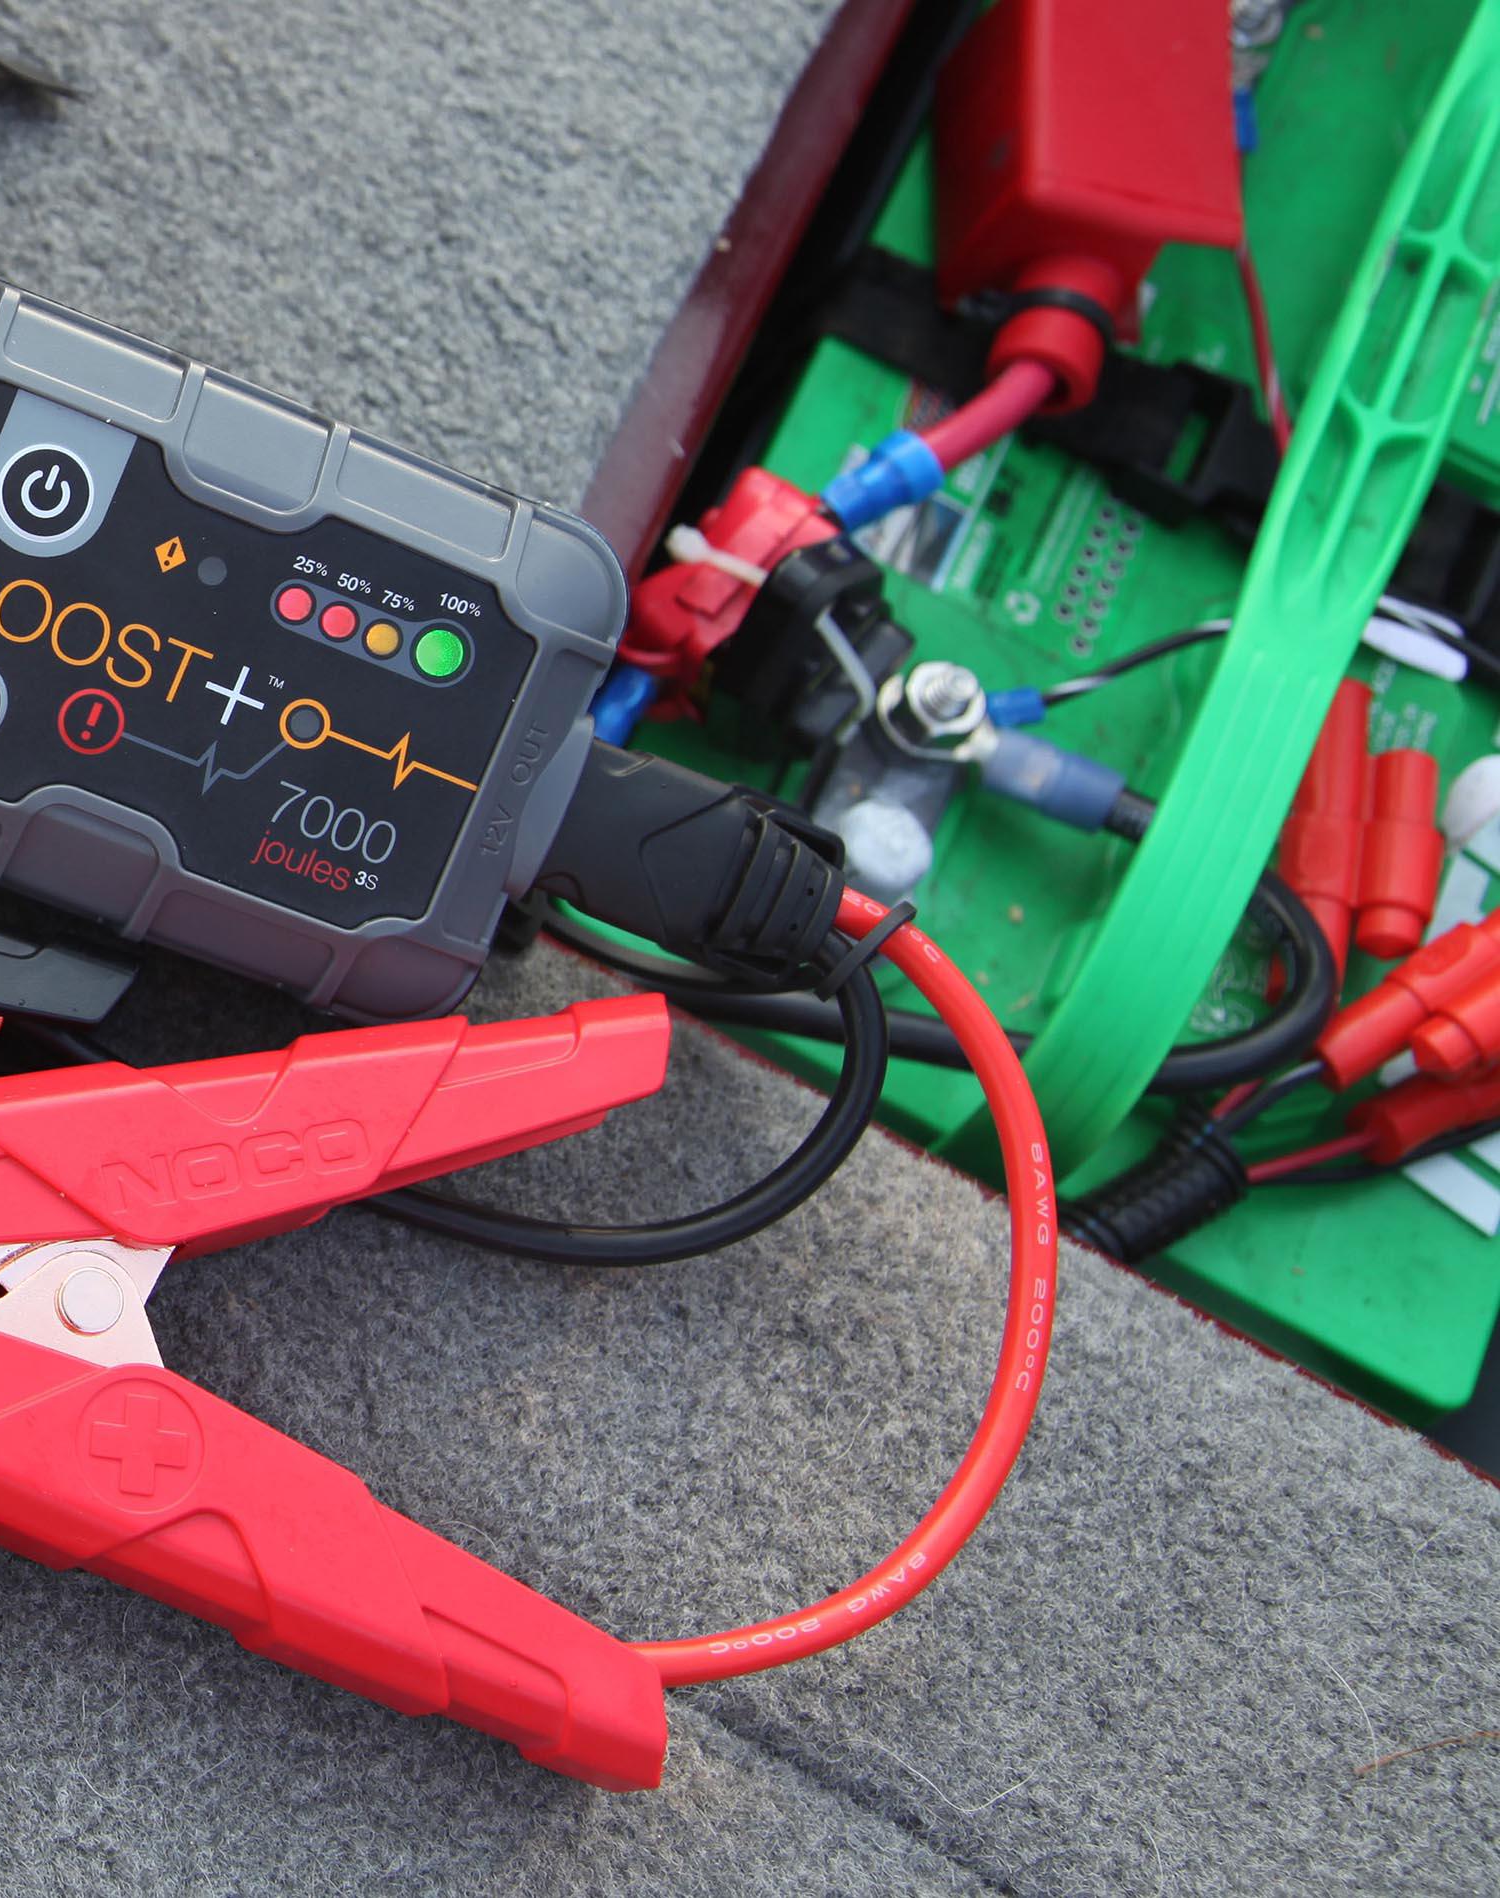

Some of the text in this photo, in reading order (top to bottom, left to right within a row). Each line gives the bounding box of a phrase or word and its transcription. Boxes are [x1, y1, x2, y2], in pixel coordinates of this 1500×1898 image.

[292, 555, 482, 618] 25% 50% 75% 100%
[270, 780, 397, 864] 7000
[480, 719, 549, 856] 12V OUT
[250, 829, 351, 892] joules
[100, 1117, 371, 1216] NOCO
